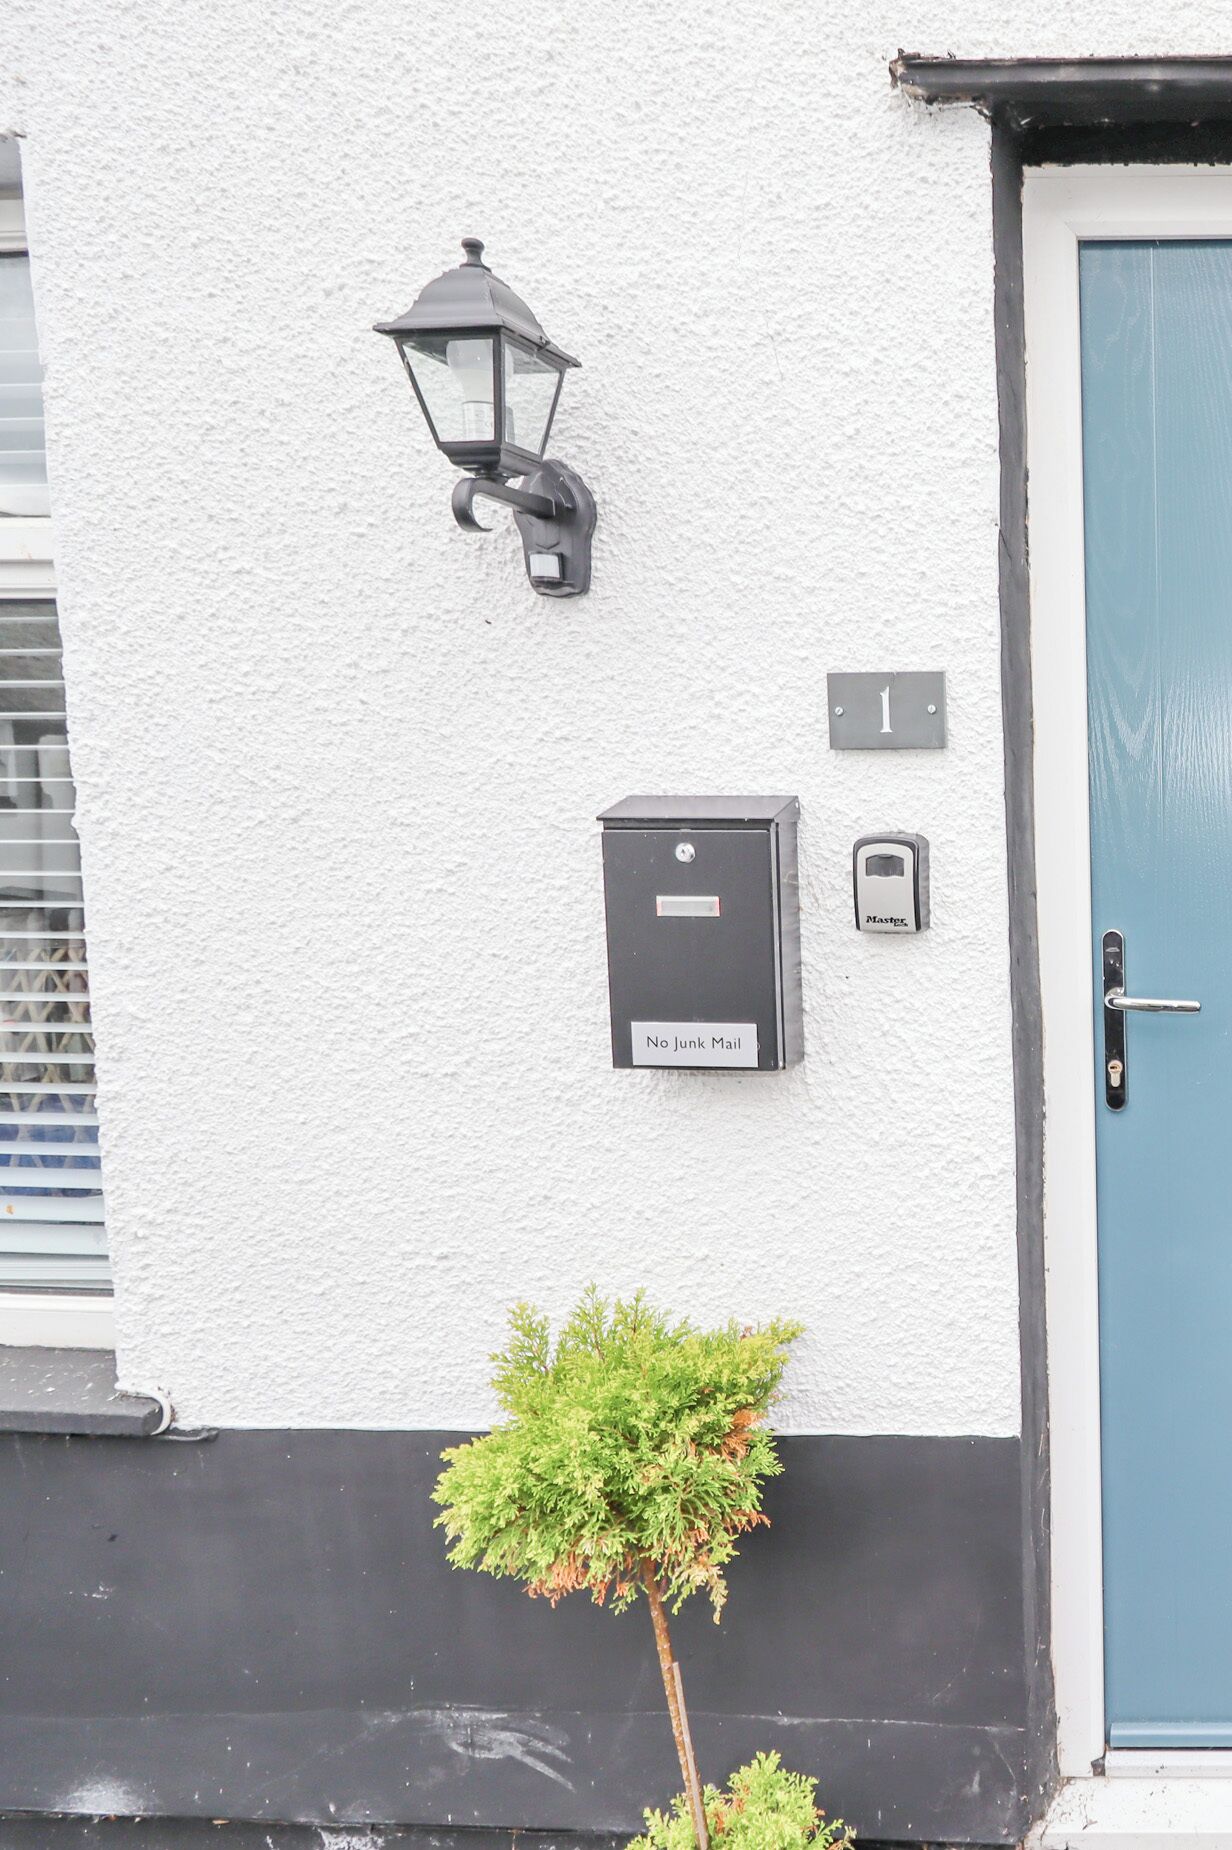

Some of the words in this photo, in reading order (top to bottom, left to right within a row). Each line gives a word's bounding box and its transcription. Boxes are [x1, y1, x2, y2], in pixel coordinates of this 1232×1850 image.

[879, 686, 893, 733] 1
[647, 1035, 669, 1049] No
[674, 1036, 706, 1052] Junk
[712, 1036, 741, 1050] Mail
